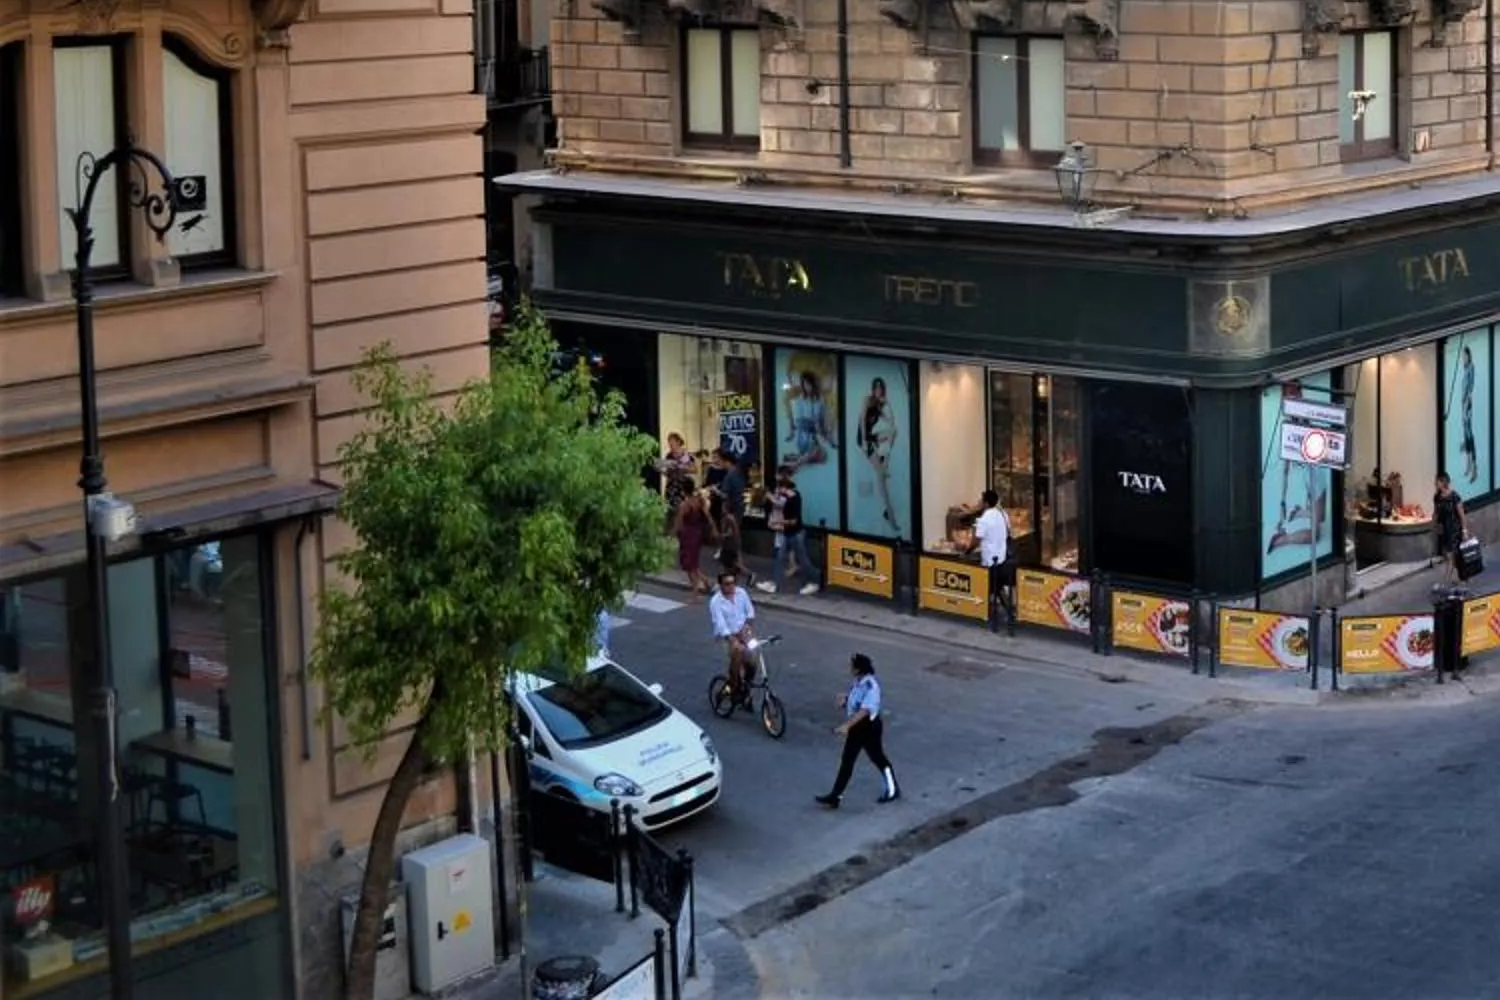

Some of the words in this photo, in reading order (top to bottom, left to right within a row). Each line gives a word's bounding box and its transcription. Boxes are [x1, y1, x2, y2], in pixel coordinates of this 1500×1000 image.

[717, 251, 812, 292] TATA
[1397, 247, 1470, 292] TATA
[719, 413, 755, 430] TUTTO
[728, 433, 747, 454] 70
[1118, 471, 1167, 492] TATA
